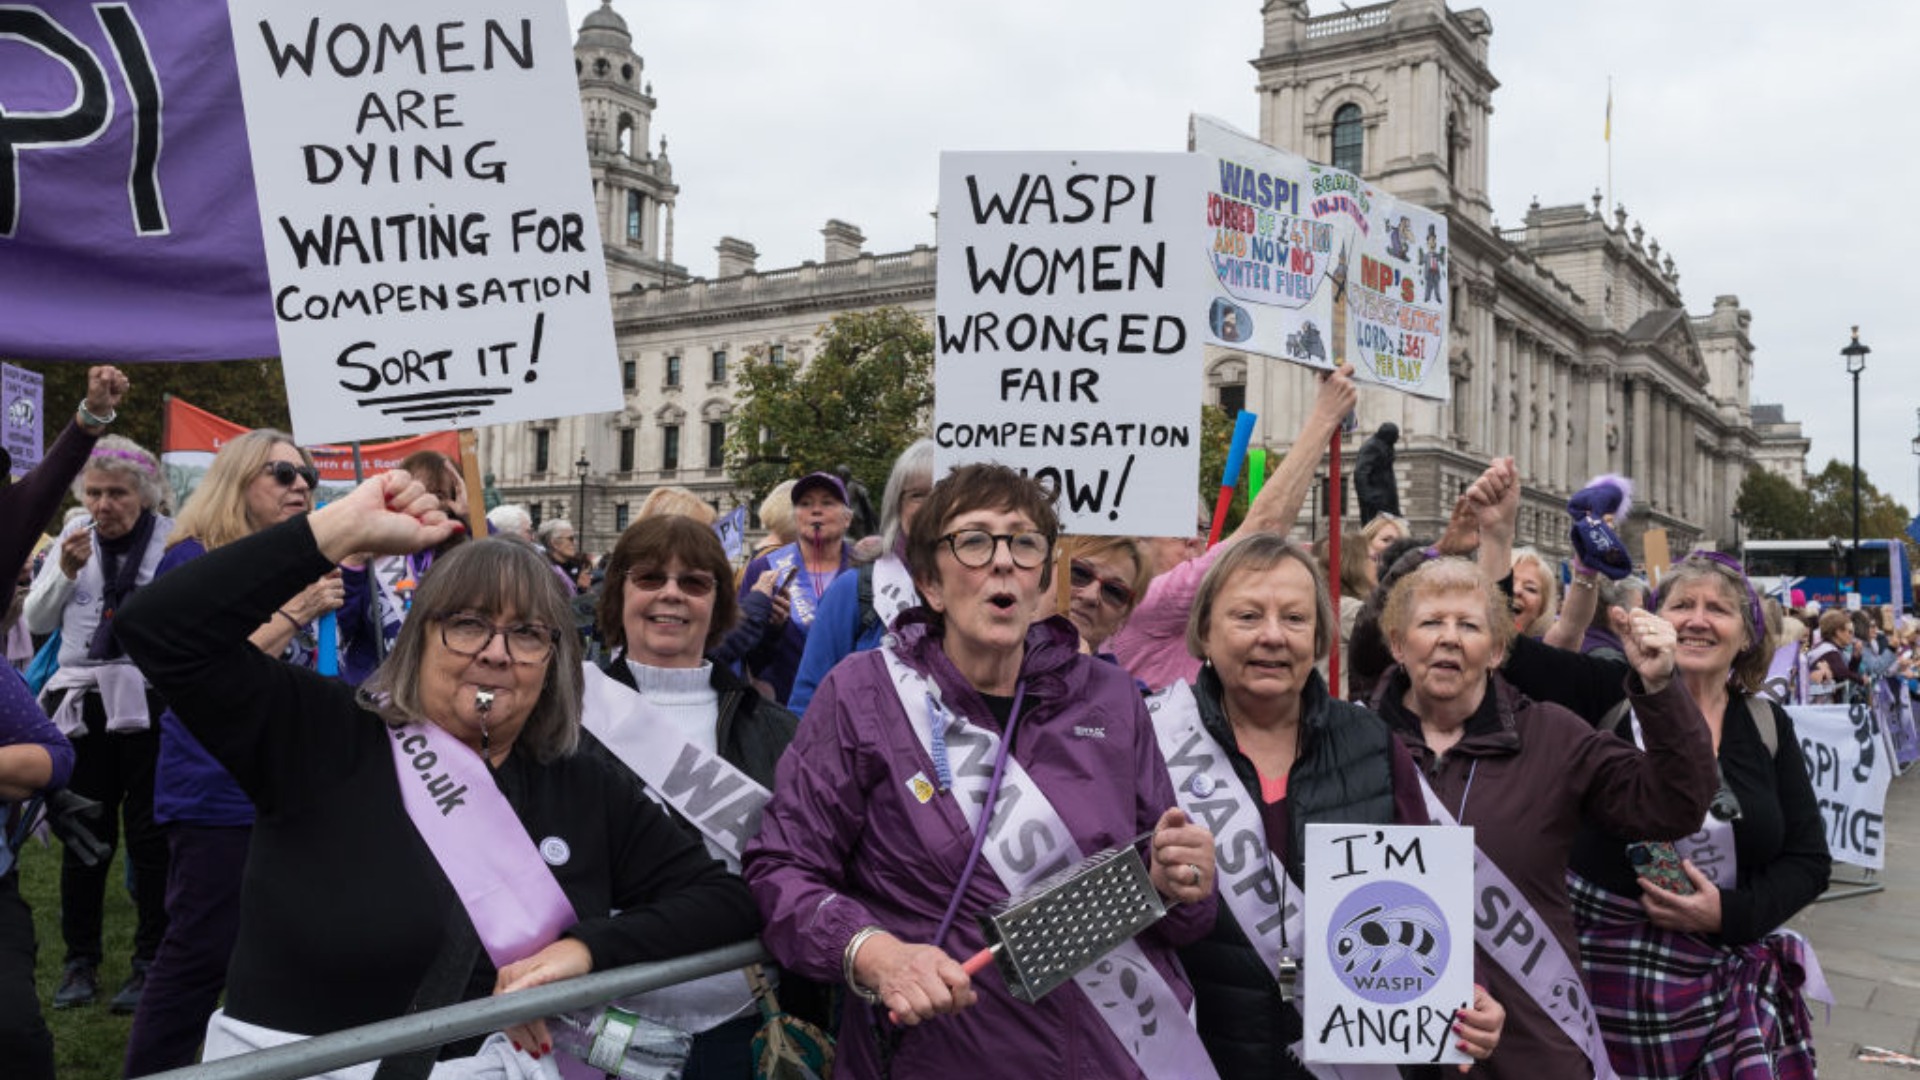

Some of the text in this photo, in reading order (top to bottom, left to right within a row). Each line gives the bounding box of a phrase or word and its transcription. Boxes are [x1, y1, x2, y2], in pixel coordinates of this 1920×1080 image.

[258, 17, 535, 79] WOMEN
[355, 90, 465, 135] ARE
[303, 141, 508, 185] DYING
[1219, 158, 1299, 216] WASPI
[965, 173, 1156, 225] WASPI
[279, 202, 586, 269] WAITING FOR
[1213, 230, 1314, 276] AND NOW NO
[965, 241, 1166, 295] WOMEN
[1213, 253, 1271, 291] WINTER
[1361, 253, 1415, 303] MP'S
[275, 270, 592, 323] COMPENSATION
[336, 312, 545, 393] SORT IT!
[937, 312, 1187, 355] WRONGED
[1001, 368, 1100, 403] FAIR
[936, 422, 1190, 448] COMPENSATION
[1331, 831, 1426, 880] I'M
[1353, 976, 1423, 993] WASPI
[1319, 1001, 1467, 1063] ANGRY
